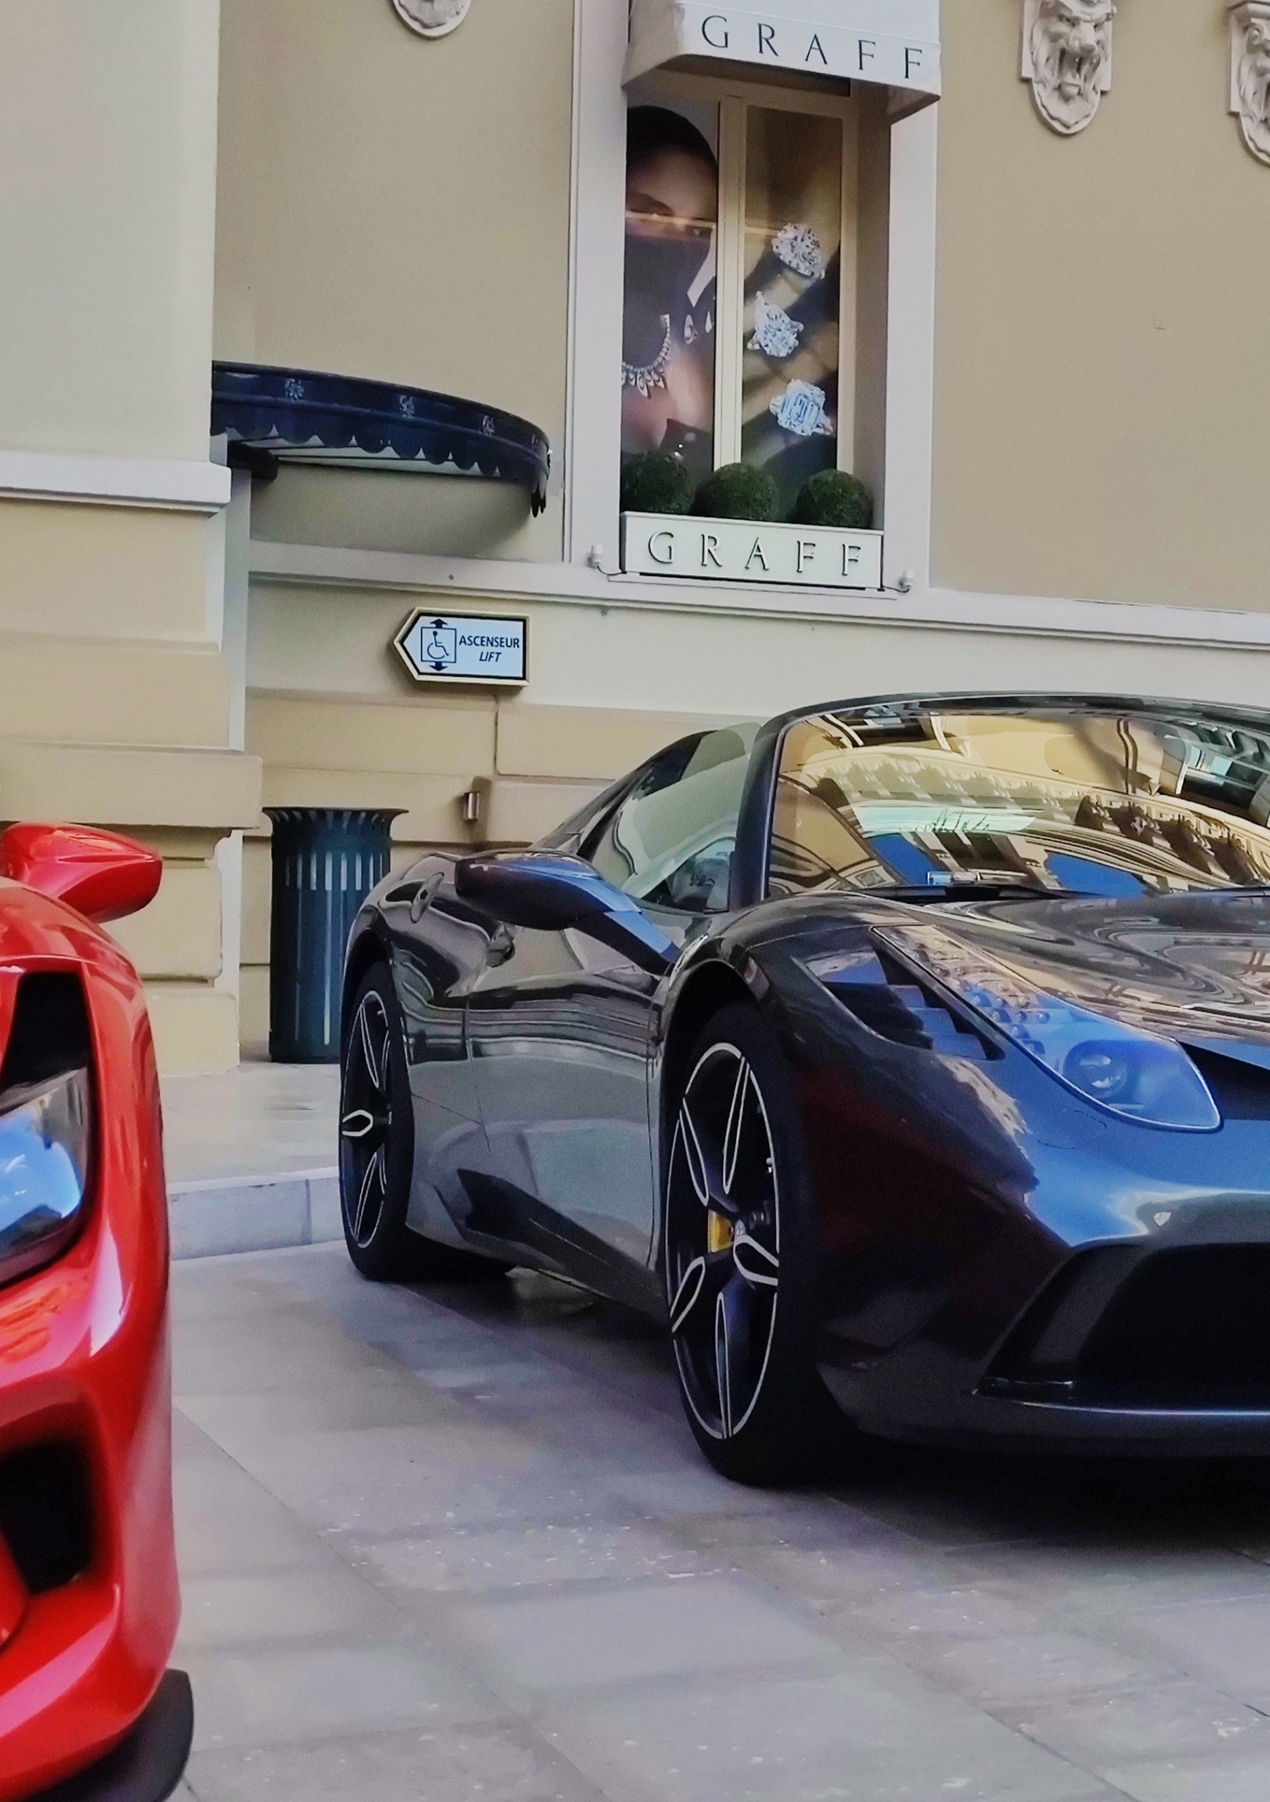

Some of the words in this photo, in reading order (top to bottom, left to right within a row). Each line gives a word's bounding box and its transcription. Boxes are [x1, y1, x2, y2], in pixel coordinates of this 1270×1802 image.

[701, 15, 922, 78] GRAFF
[648, 531, 861, 576] GRAFF
[458, 635, 520, 648] ASCENSEUR
[478, 651, 502, 662] LIFT
